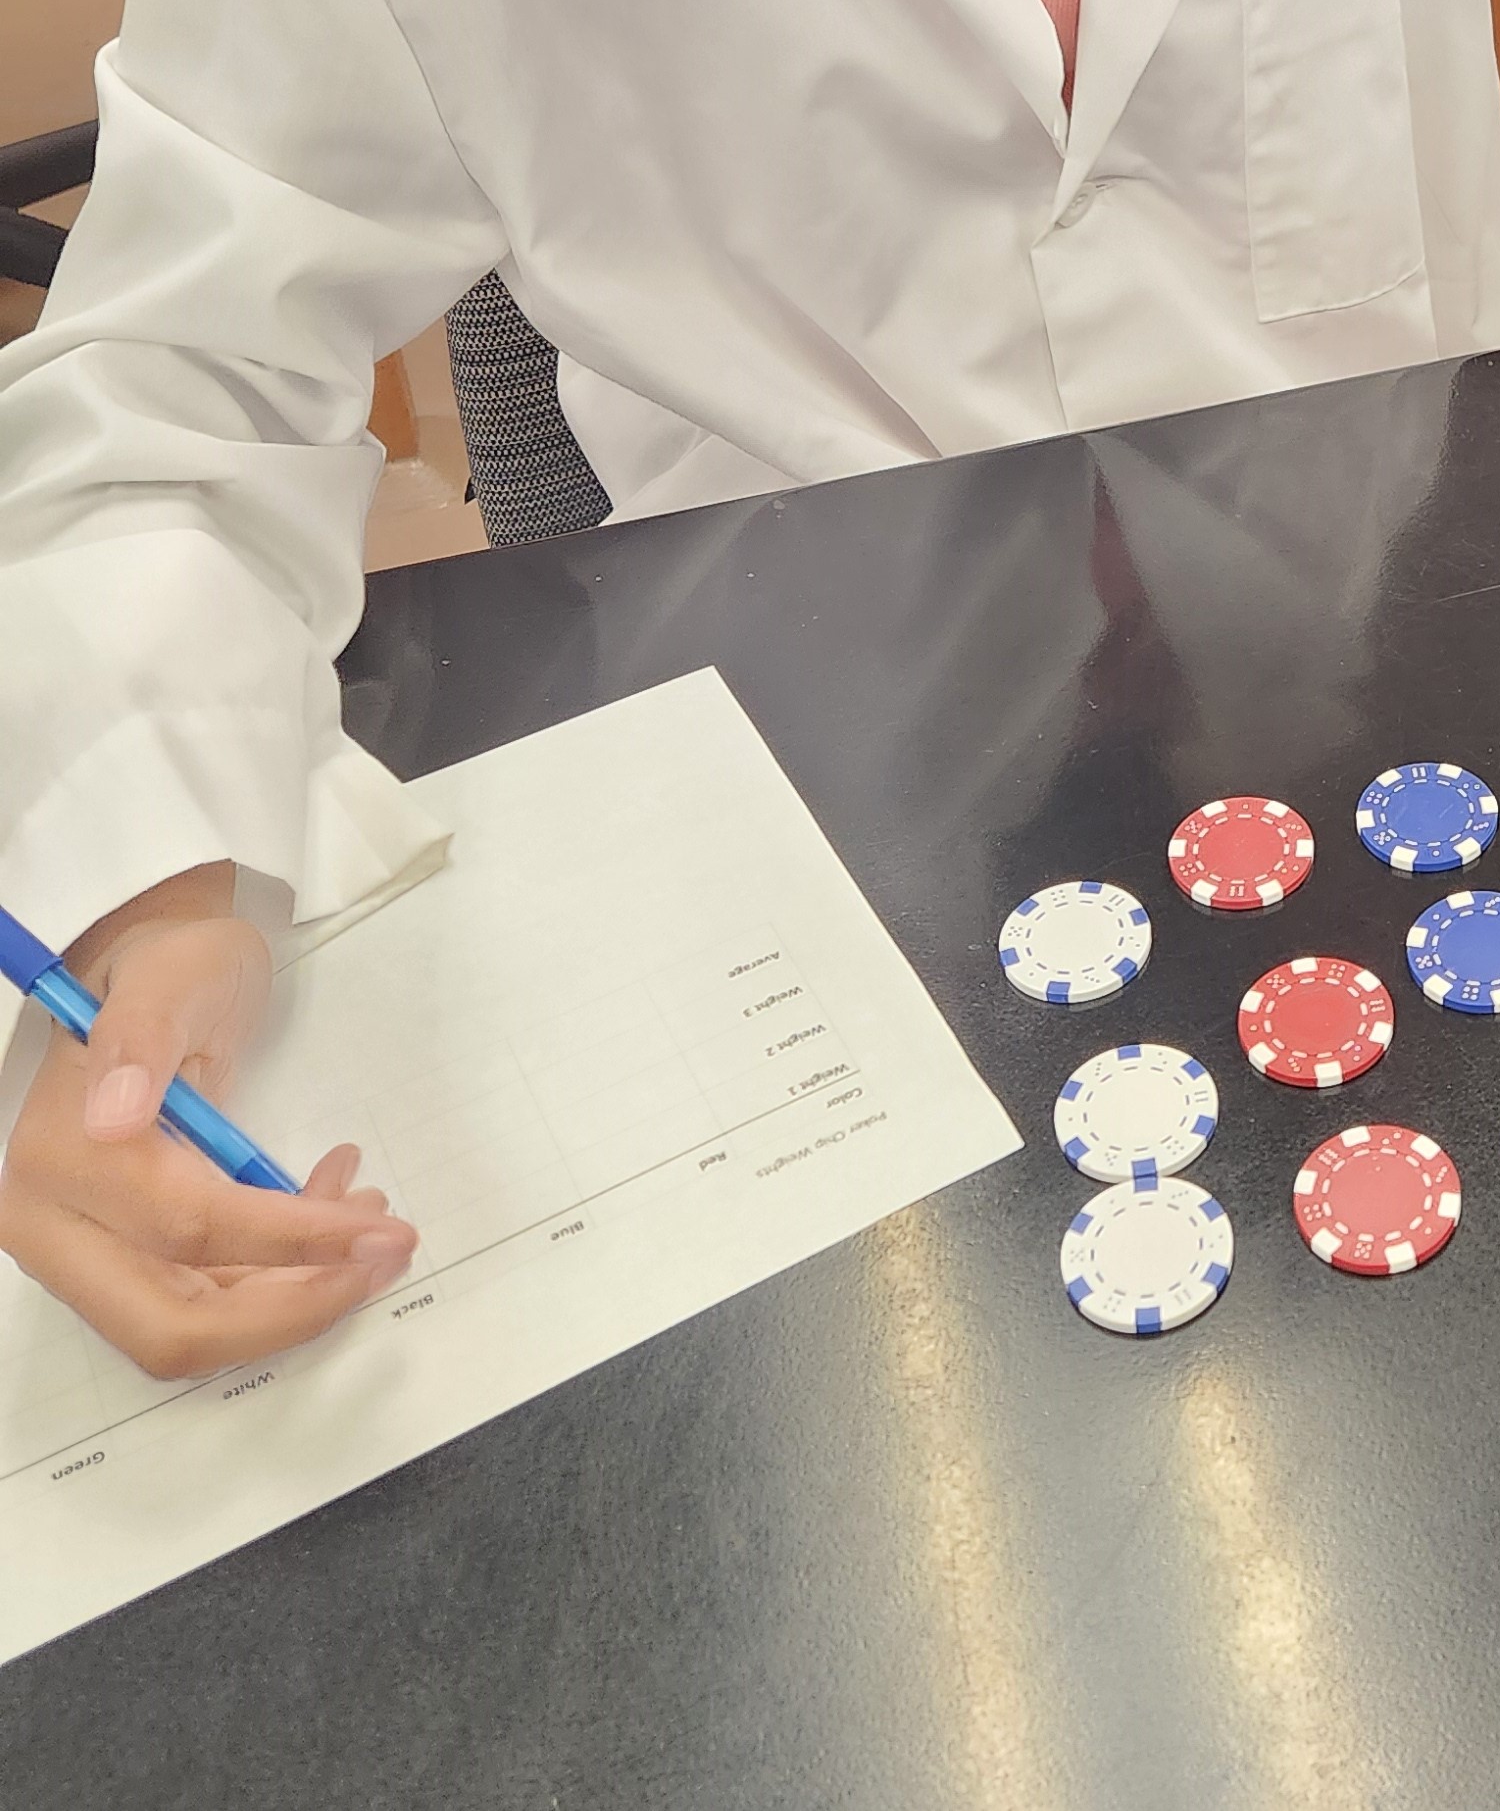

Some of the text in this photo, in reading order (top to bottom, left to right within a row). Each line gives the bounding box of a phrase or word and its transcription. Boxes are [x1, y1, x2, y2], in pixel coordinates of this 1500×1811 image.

[727, 950, 781, 978] Average
[742, 986, 803, 1017] Weight 3
[765, 1024, 826, 1057] Weight 2
[787, 1062, 850, 1096] Weight 1
[826, 1087, 863, 1109] Color
[755, 1110, 887, 1178] Poker Chip Weights
[699, 1151, 727, 1171] Red
[550, 1220, 585, 1241] Blue
[391, 1293, 435, 1320] Black
[222, 1371, 275, 1400] White
[51, 1451, 106, 1481] Green
